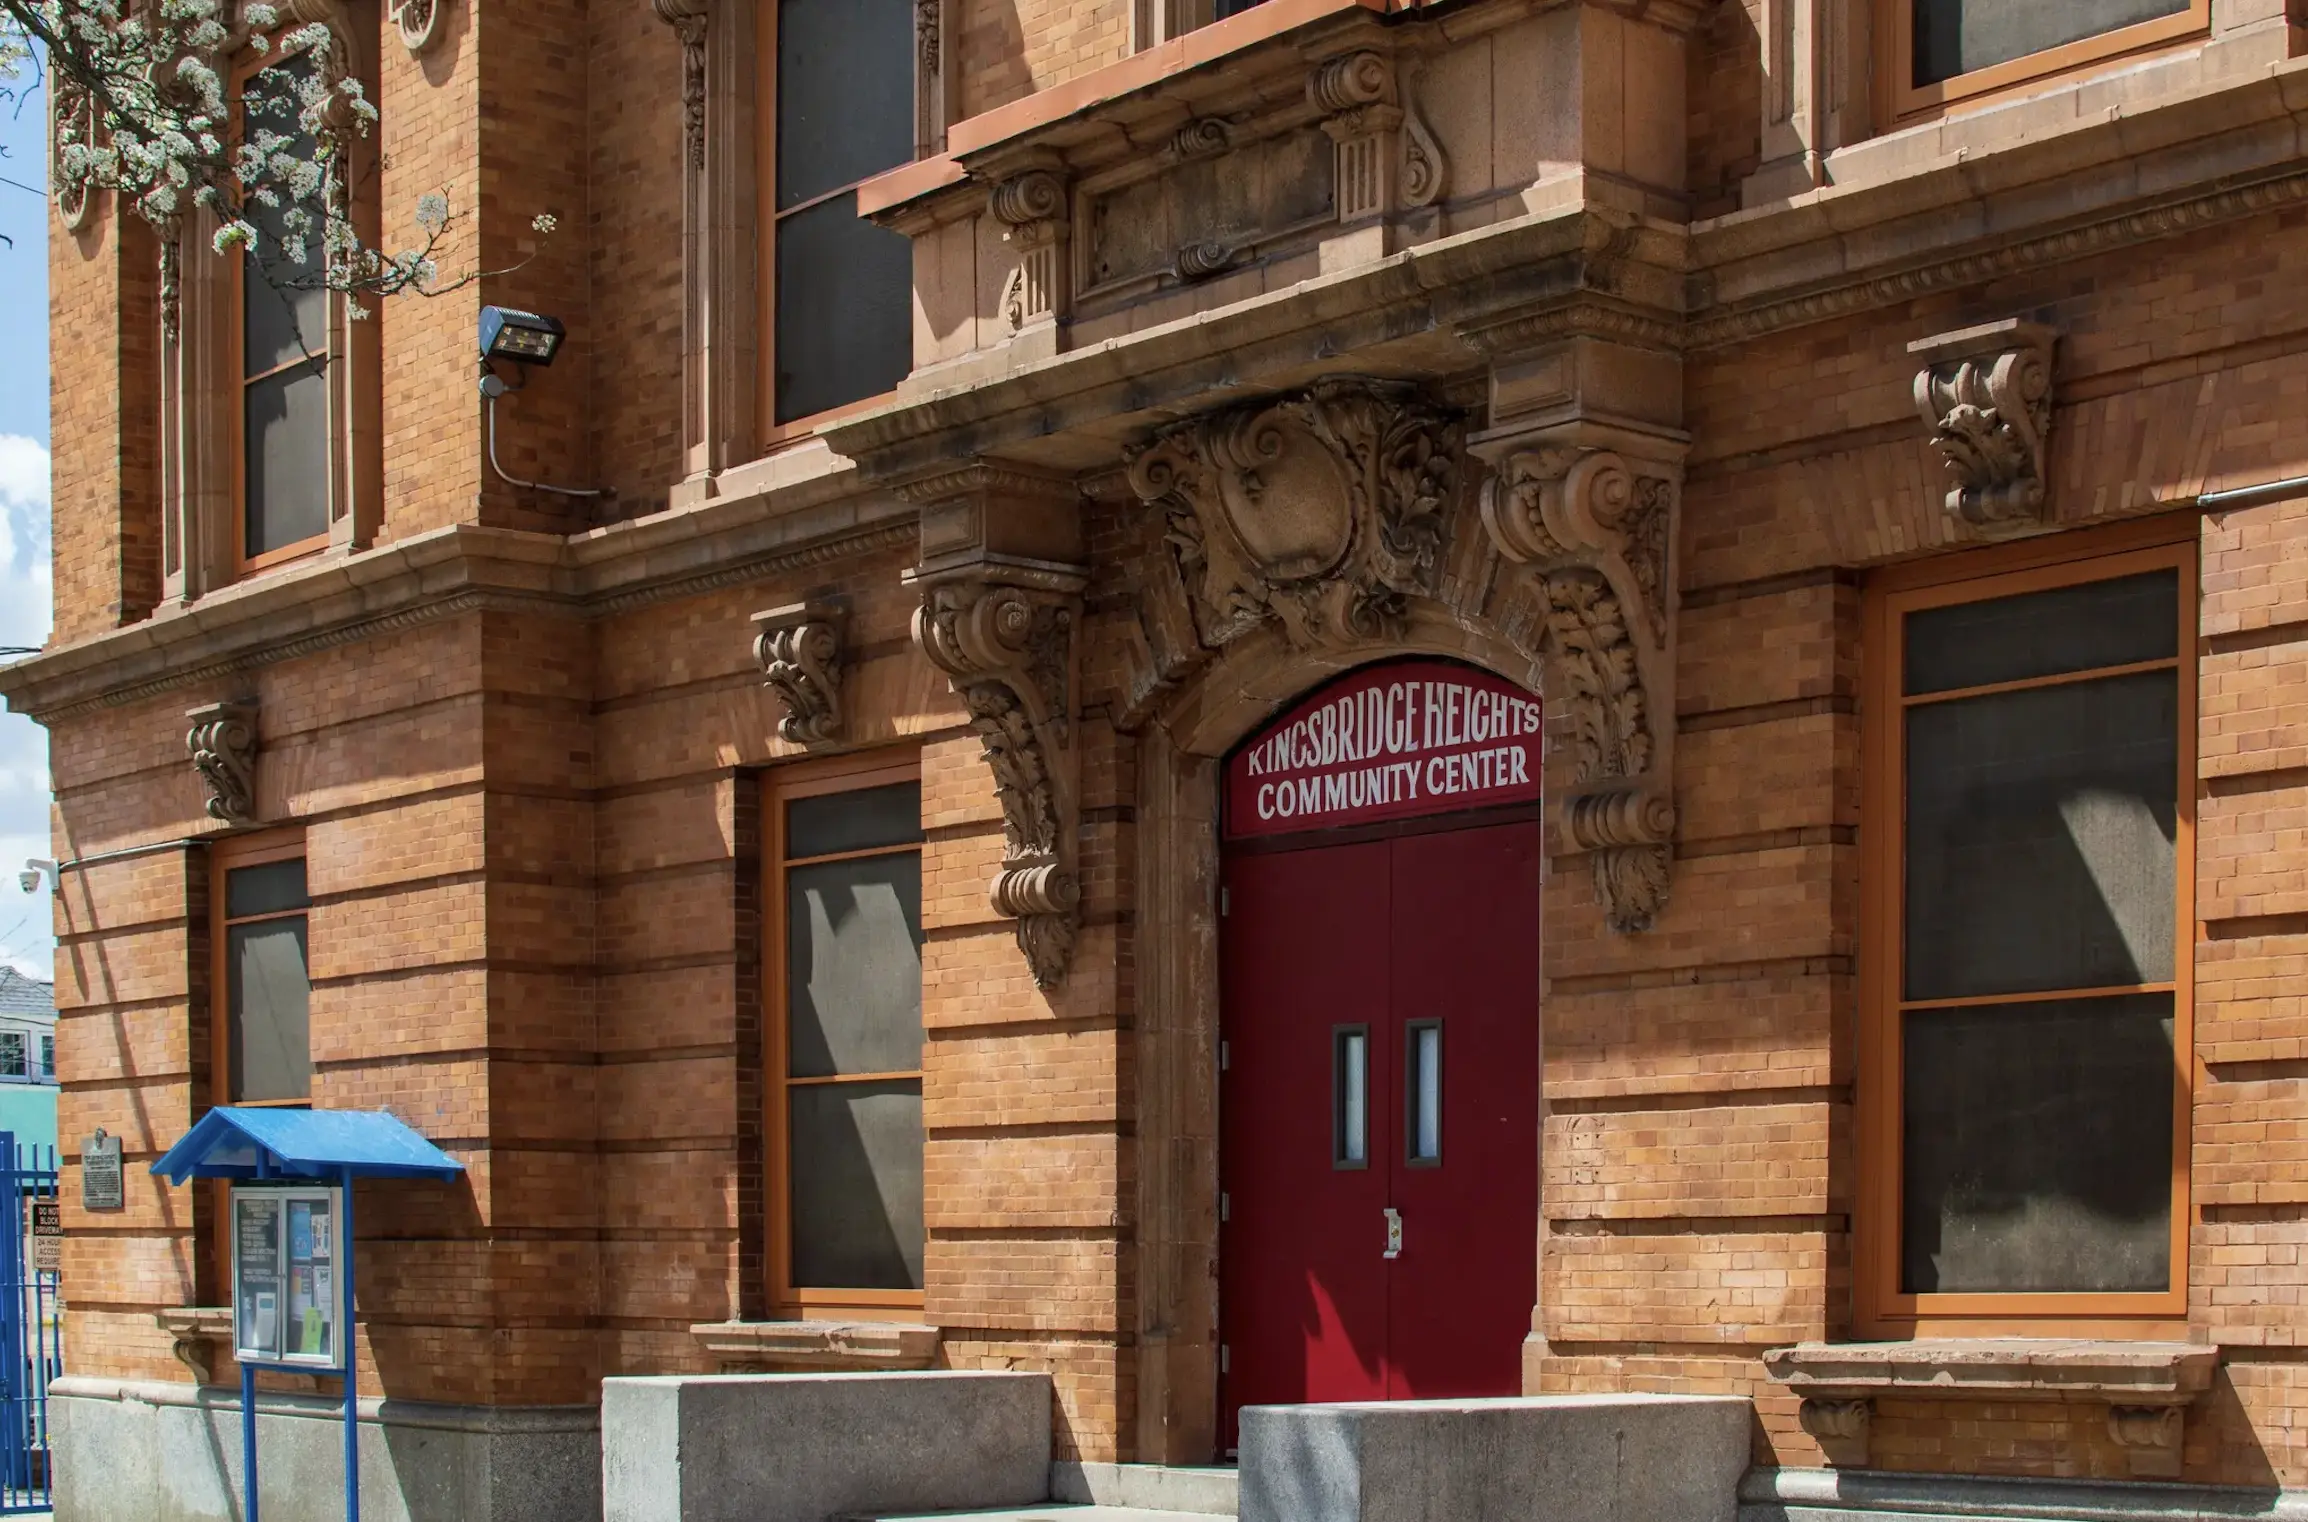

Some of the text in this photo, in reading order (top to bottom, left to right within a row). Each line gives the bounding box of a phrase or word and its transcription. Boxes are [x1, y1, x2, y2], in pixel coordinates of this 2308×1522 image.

[1248, 681, 1540, 776] KINGSBRIDGE HEIGHTS
[1257, 746, 1530, 820] COMMUNITY CENTER
[38, 1207, 47, 1215] DO
[40, 1216, 59, 1225] BLOCK
[37, 1238, 45, 1246] 24
